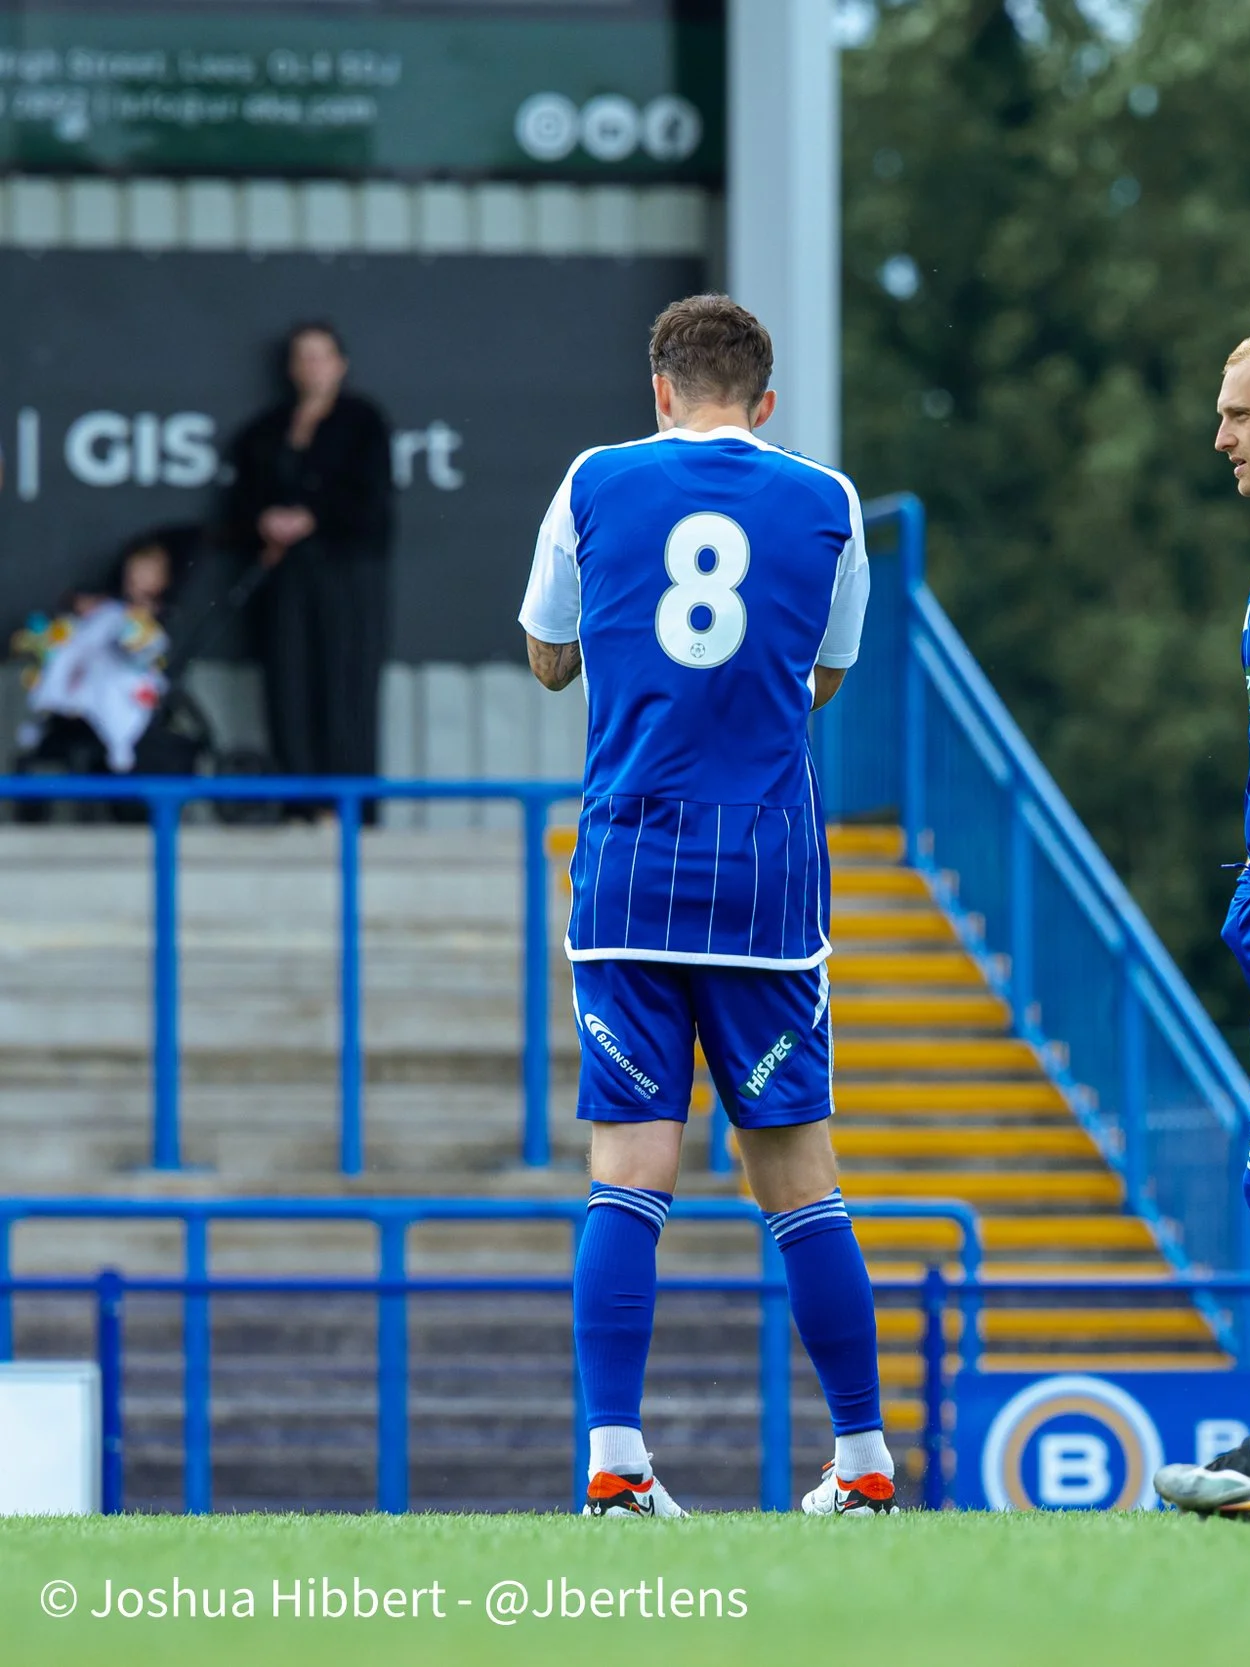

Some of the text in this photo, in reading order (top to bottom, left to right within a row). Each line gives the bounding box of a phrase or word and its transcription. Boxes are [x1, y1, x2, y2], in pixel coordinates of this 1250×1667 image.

[655, 511, 750, 669] 8
[596, 1033, 660, 1095] BARNSHAWS
[746, 1035, 793, 1096] HiSPEC
[1040, 1433, 1111, 1504] B
